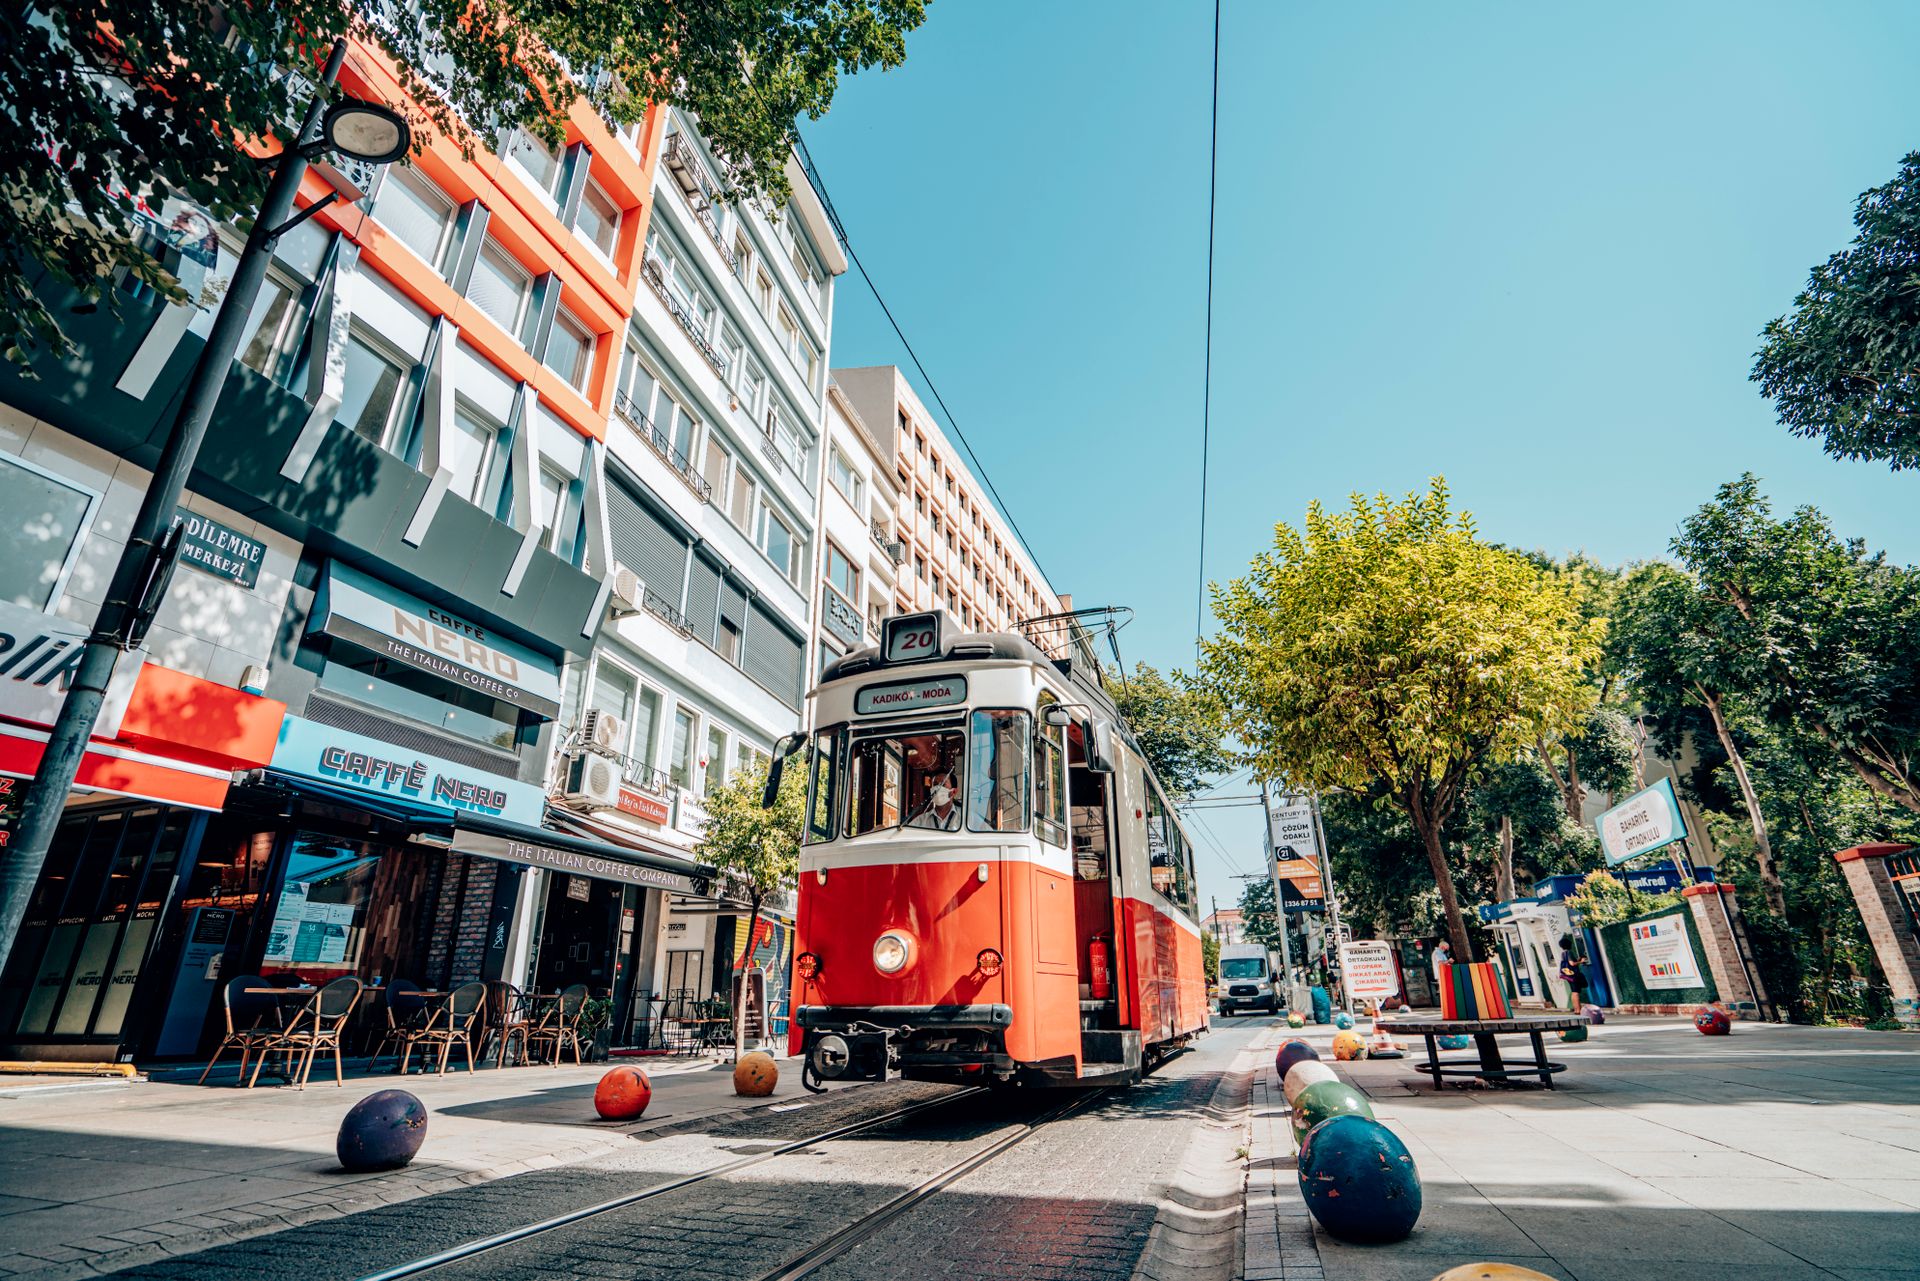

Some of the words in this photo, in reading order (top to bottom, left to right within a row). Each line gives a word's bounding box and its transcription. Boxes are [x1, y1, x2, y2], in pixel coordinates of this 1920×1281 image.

[187, 517, 261, 563] DİLEMRE
[182, 542, 245, 577] MERKEZİ
[429, 609, 485, 641] CAFFÈ
[901, 631, 933, 650] 20
[394, 608, 518, 682] NERO
[387, 641, 410, 658] THE
[413, 652, 459, 678] ITALIAN
[463, 672, 503, 695] COFFEE
[923, 688, 951, 699] MODA
[318, 746, 428, 797] CAFFÈ
[432, 773, 507, 815] NERO
[1272, 811, 1300, 819] CENTURY
[1282, 823, 1309, 832] ÇÖZÜM
[1283, 832, 1310, 840] ODAKLI
[508, 842, 533, 859] THE
[536, 850, 583, 868] ITALIAN
[586, 859, 629, 878] COFFEE
[632, 867, 682, 887] COMPANY
